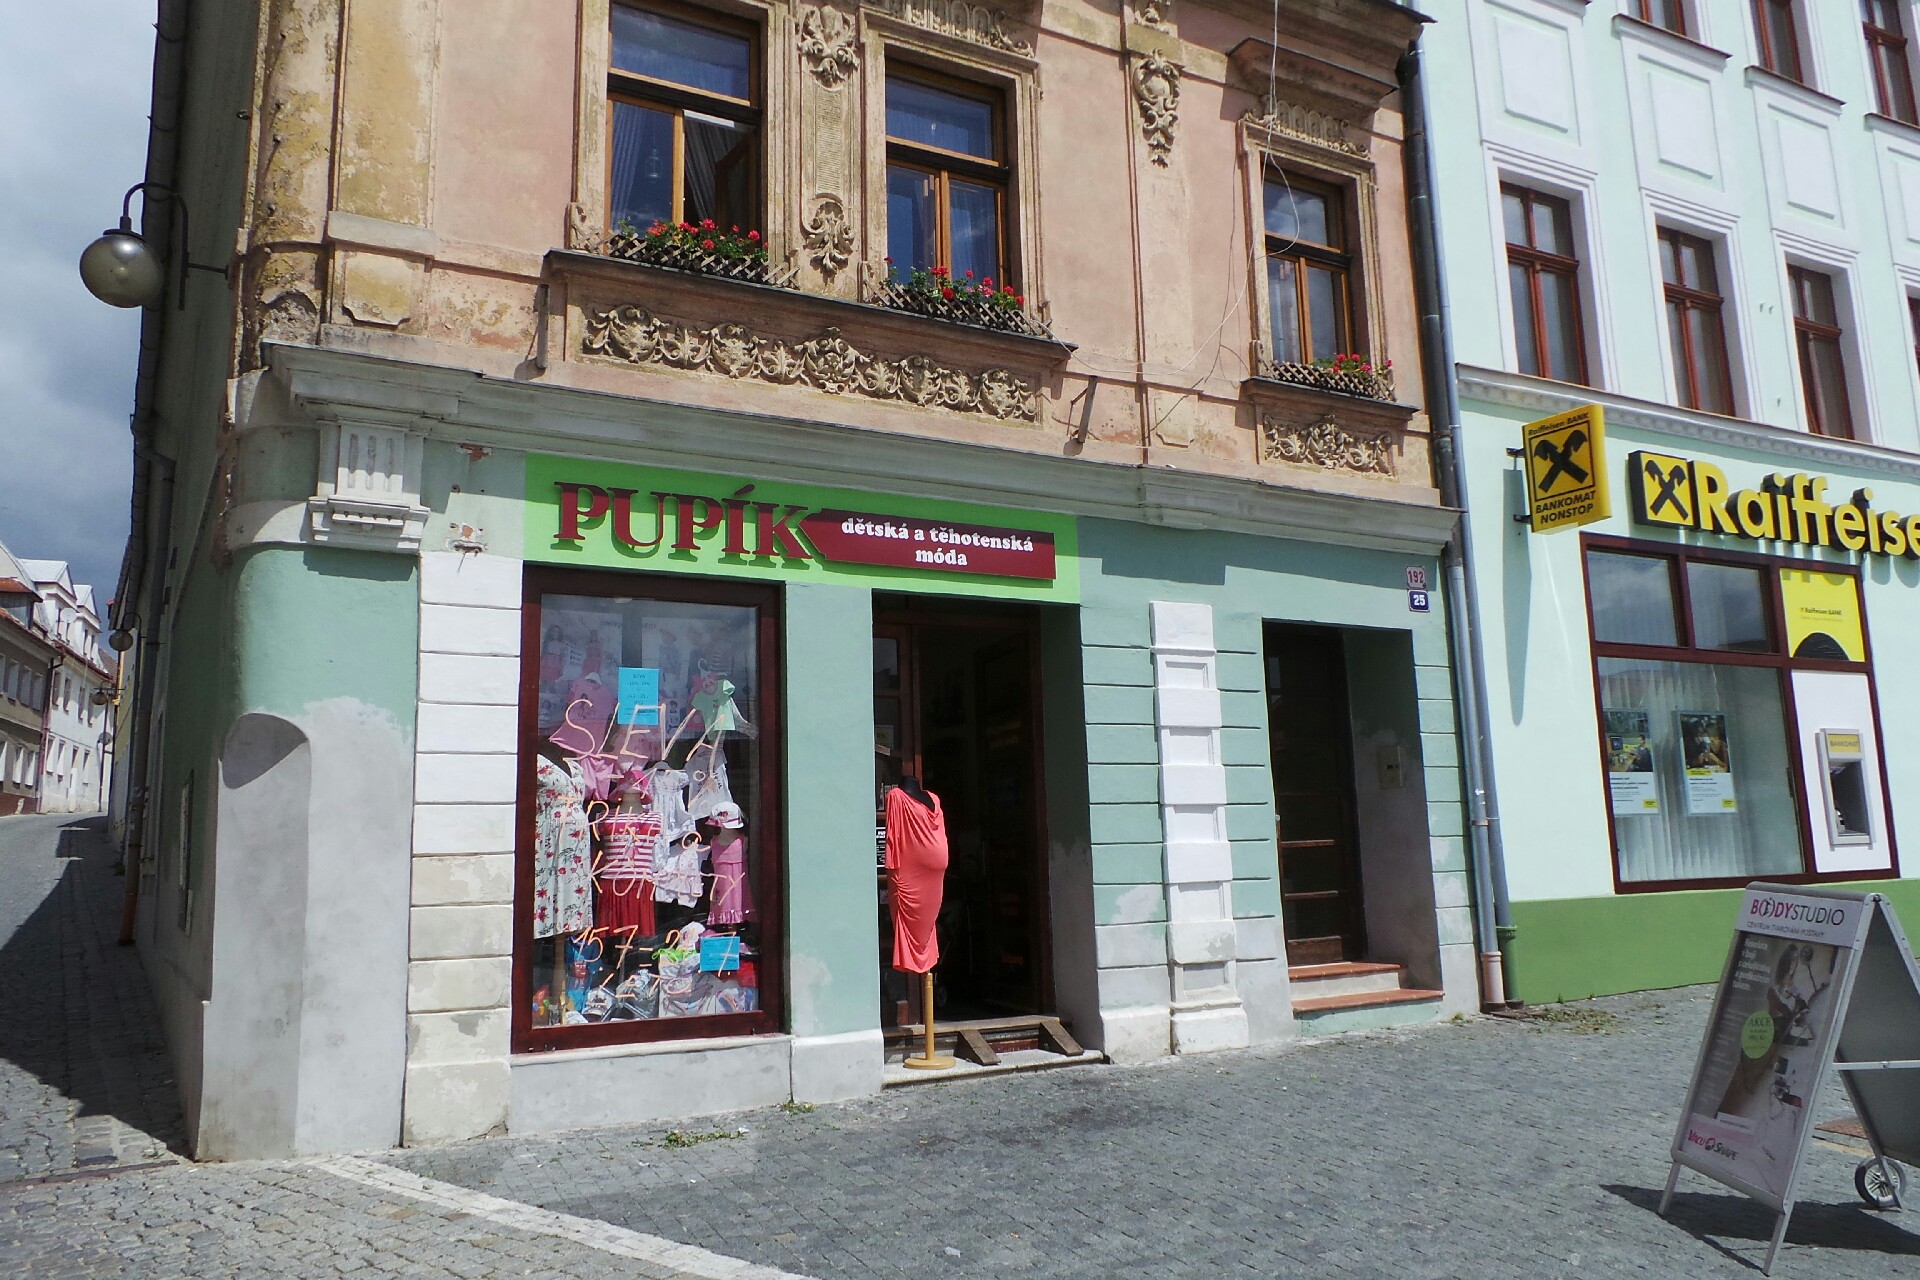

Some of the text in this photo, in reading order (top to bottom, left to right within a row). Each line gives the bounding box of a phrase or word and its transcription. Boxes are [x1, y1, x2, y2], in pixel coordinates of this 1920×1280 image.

[1567, 413, 1589, 425] BANK
[1536, 490, 1596, 514] BANKOMAT
[553, 482, 815, 560] PUPÍK
[1540, 503, 1594, 525] NONSTOP
[841, 517, 1034, 552] dětská a těhotenská
[915, 547, 968, 566] móda
[1407, 570, 1424, 584] 192
[1413, 594, 1426, 606] 25
[562, 699, 726, 779] SLEVA
